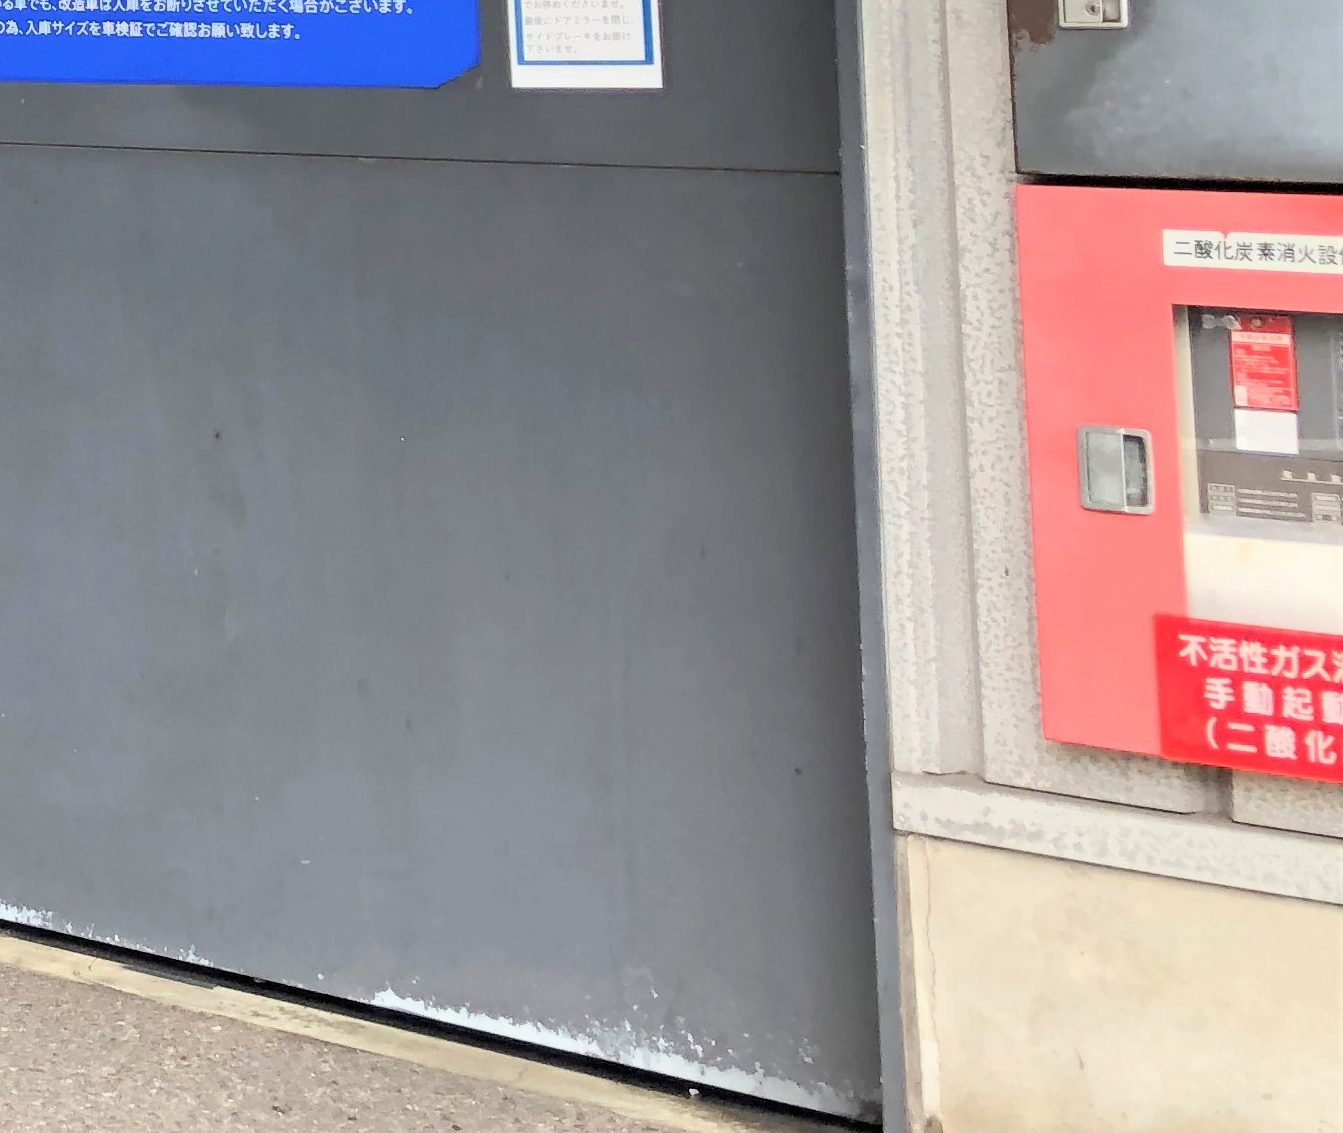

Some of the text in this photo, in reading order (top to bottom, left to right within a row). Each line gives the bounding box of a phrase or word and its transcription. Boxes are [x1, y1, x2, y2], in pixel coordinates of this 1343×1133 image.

[1174, 239, 1343, 266] 二酸化炭素消火設
